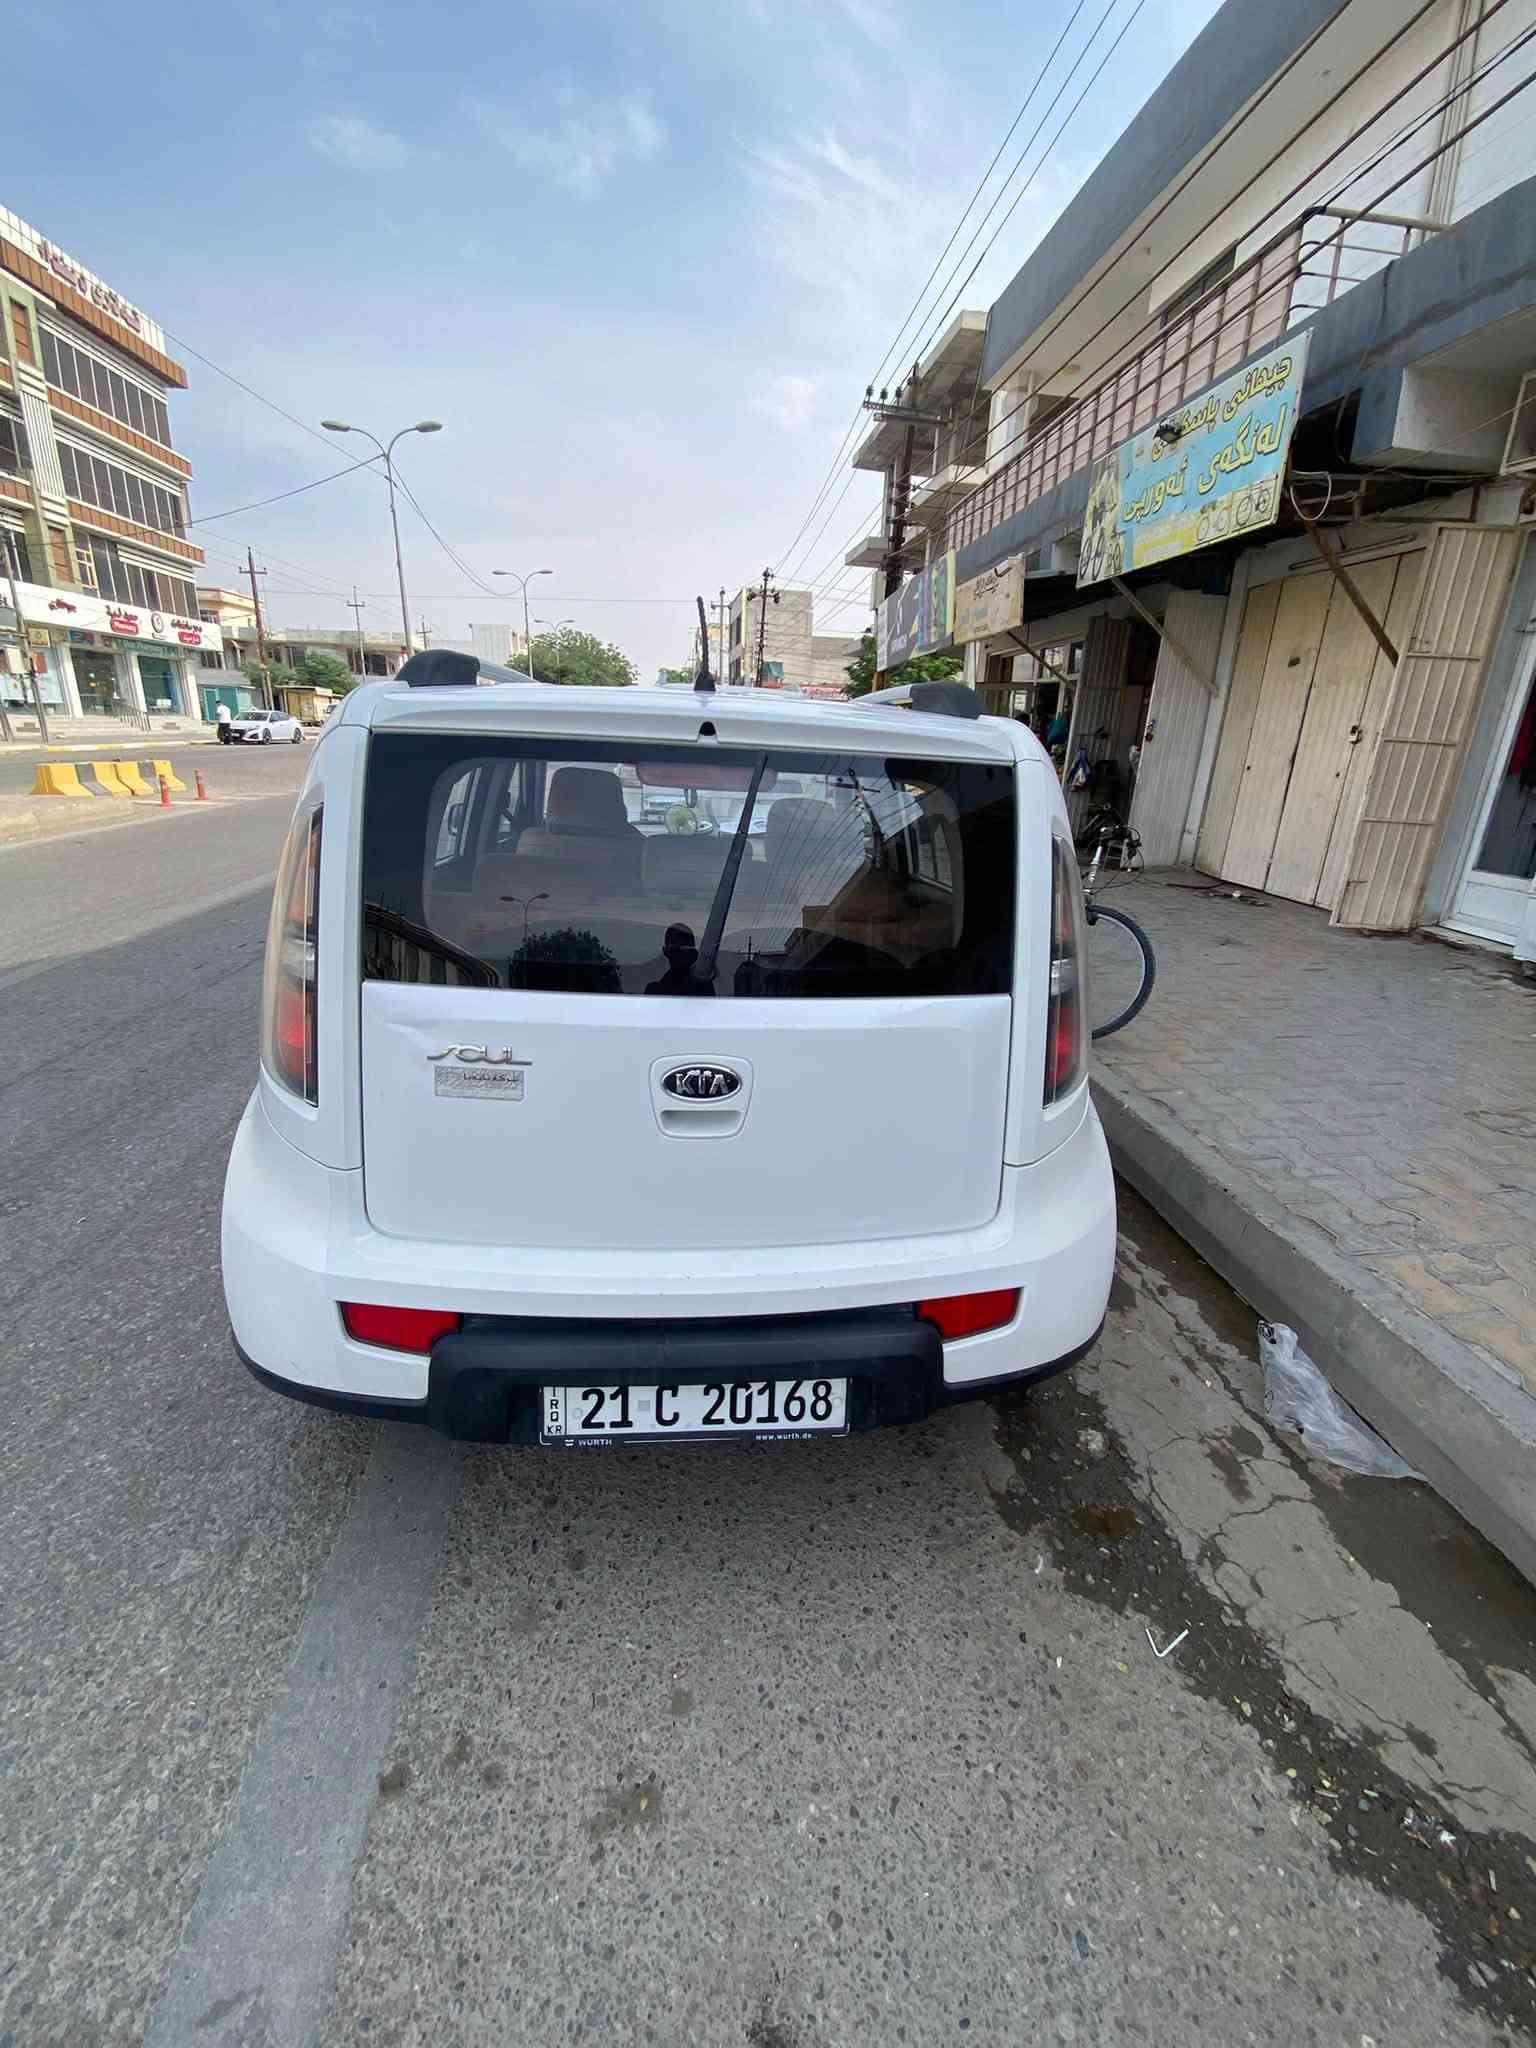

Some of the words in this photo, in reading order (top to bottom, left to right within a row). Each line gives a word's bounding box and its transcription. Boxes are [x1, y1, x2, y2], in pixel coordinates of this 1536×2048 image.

[675, 1070, 729, 1095] KIA
[581, 1388, 633, 1429] 21
[655, 1385, 680, 1426] C
